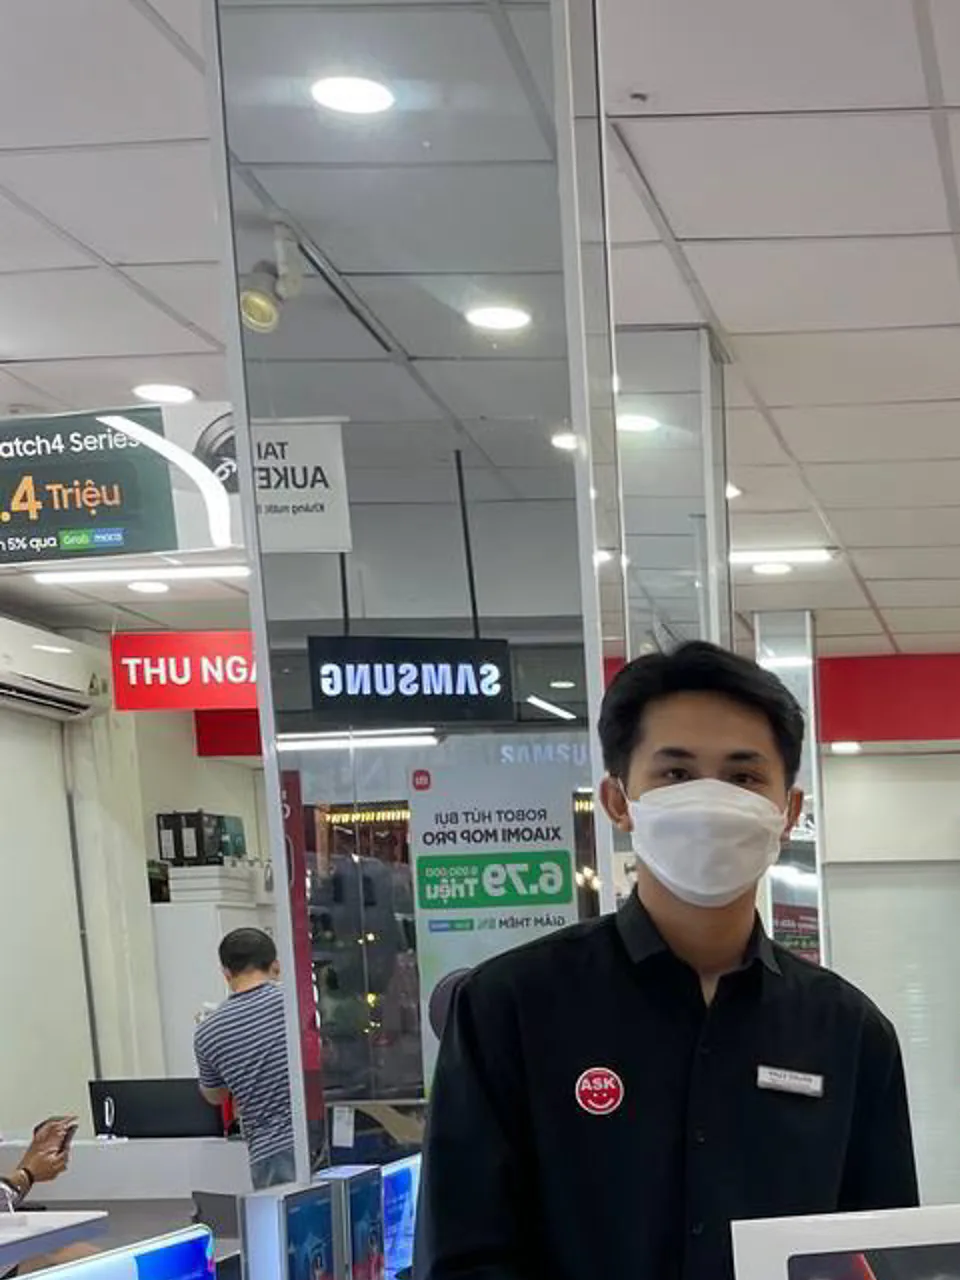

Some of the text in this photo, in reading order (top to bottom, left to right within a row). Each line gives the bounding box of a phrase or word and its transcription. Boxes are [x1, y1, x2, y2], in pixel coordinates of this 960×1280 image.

[45, 479, 121, 515] Triệu
[29, 536, 58, 553] qua
[121, 655, 257, 686] THU NG
[580, 1075, 616, 1092] ASK
